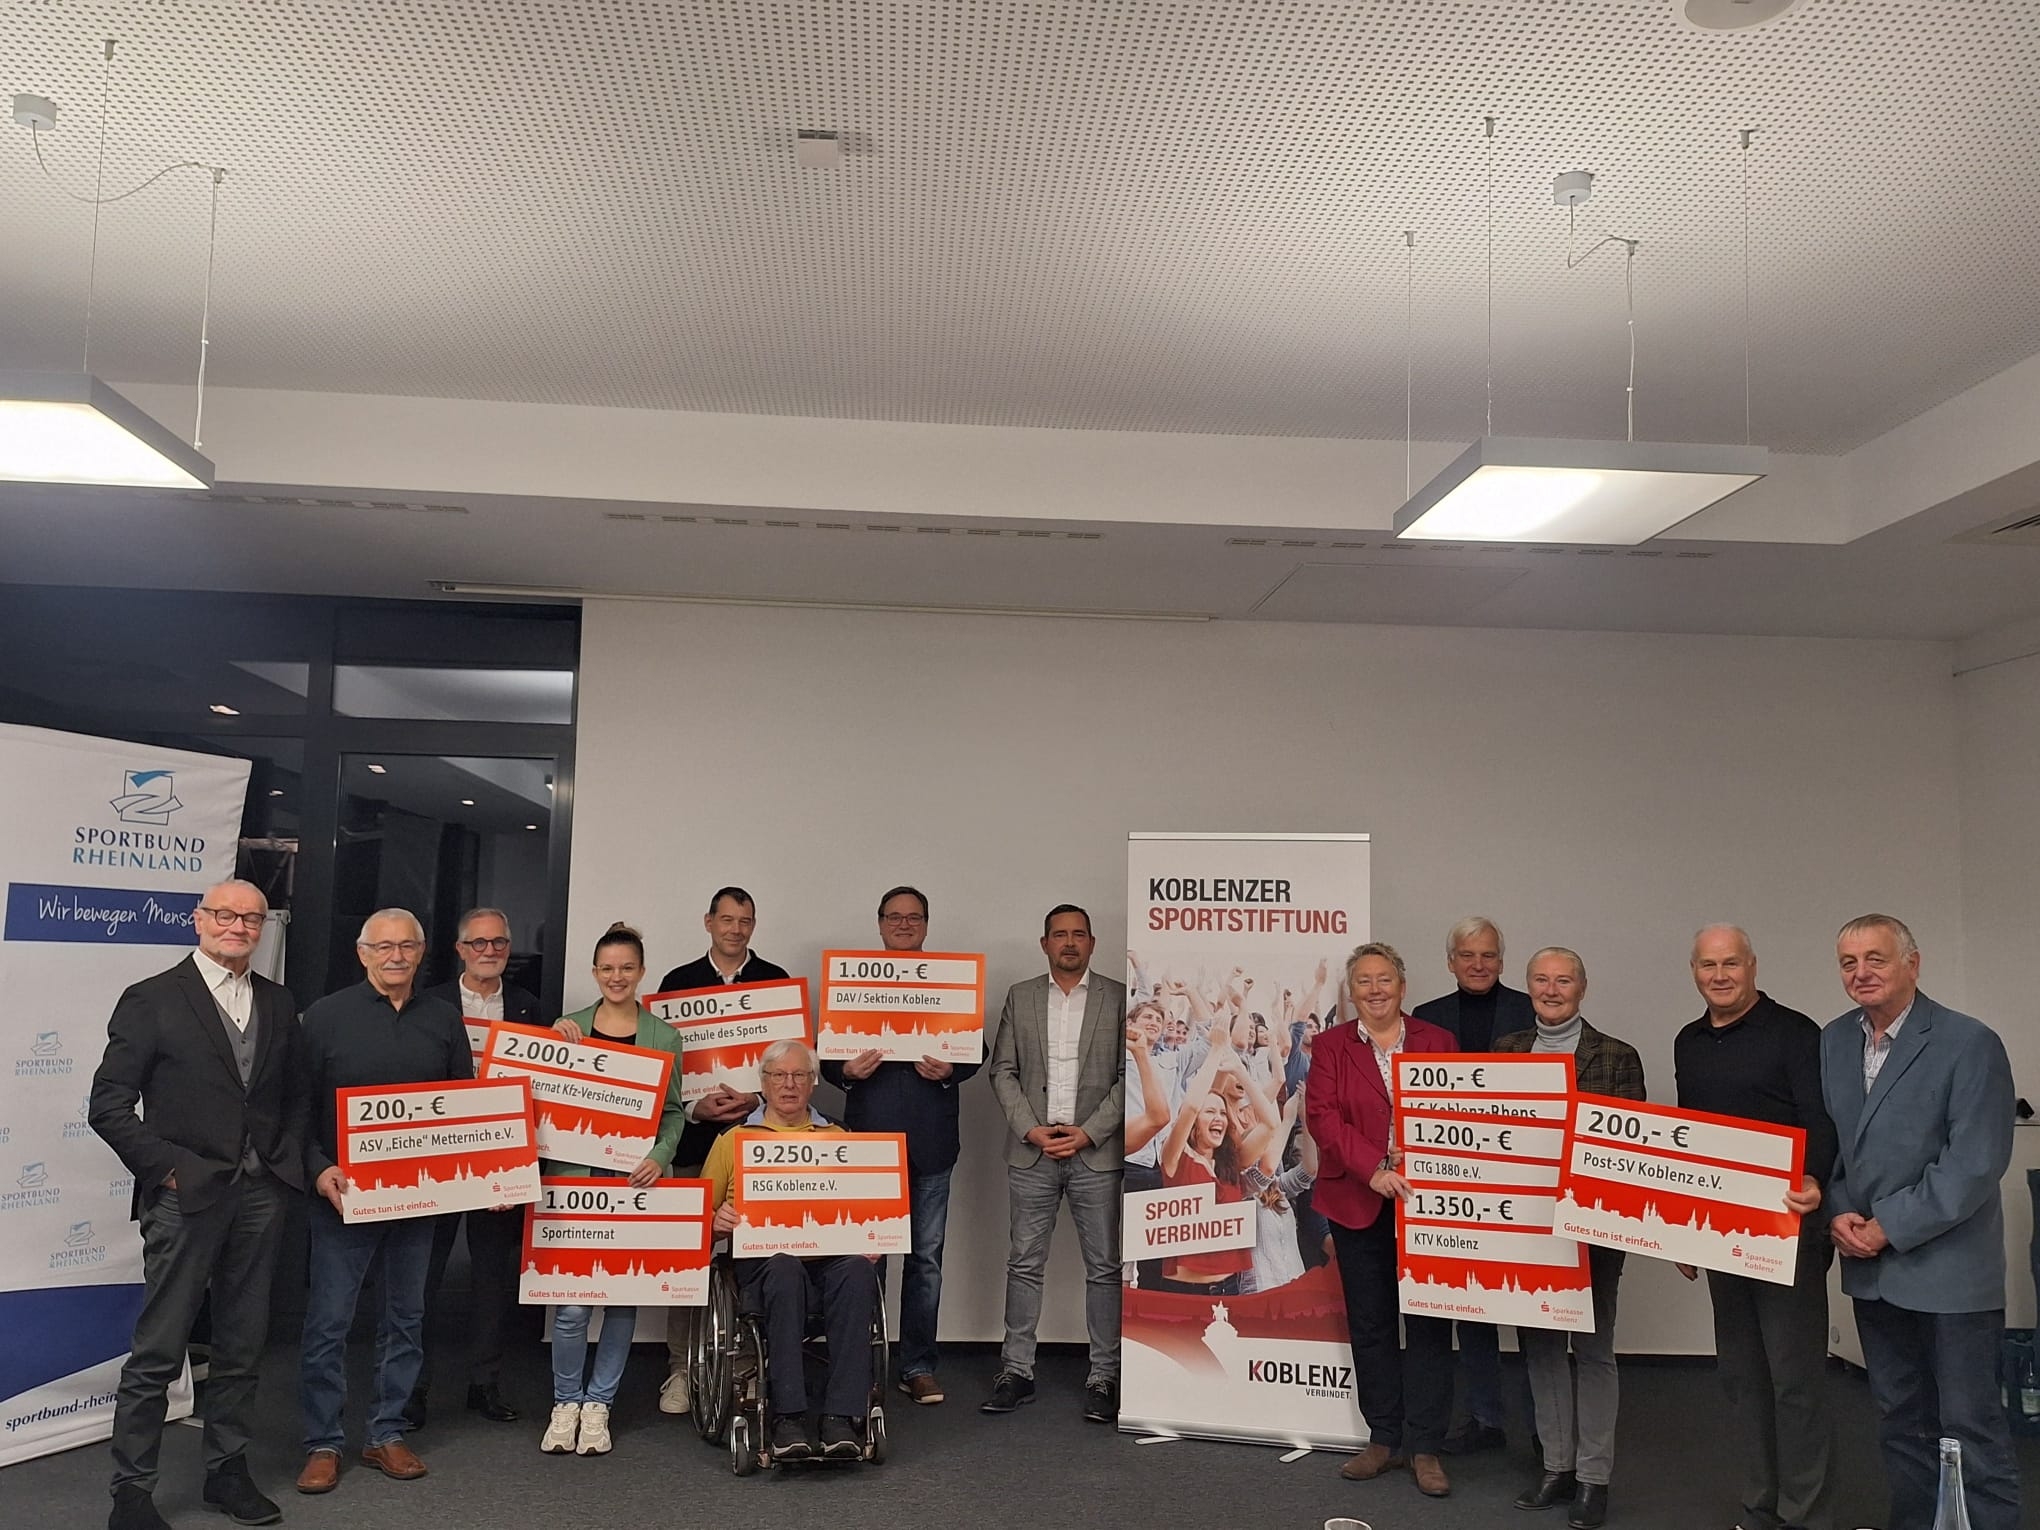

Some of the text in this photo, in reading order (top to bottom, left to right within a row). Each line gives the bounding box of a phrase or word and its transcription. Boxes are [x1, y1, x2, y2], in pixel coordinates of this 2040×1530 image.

[75, 826, 205, 854] SPORTBUND
[72, 847, 202, 873] RHEINLAND
[1149, 878, 1291, 903] KOBLENZER
[39, 894, 200, 936] Wir bewegen Mensc
[1148, 907, 1347, 934] SPORTSTIFTUNG
[839, 962, 928, 981] 1.000,- €
[661, 994, 752, 1021] 1.000,- €
[836, 992, 856, 1003] DAV
[863, 993, 900, 1004] Sektion
[902, 994, 941, 1006] Koblenz
[682, 1024, 768, 1043] schule des Sports
[16, 1058, 73, 1068] SPORTBUND
[503, 1037, 608, 1072] 2.000,- €
[15, 1066, 72, 1077] RHEINLAND
[1409, 1067, 1486, 1090] 200,- €
[562, 1084, 643, 1111] Kfz-Versicherung
[359, 1095, 446, 1121] 200,- €
[1414, 1122, 1512, 1151] 1.200,- €
[1588, 1110, 1690, 1148] 200,- €
[359, 1127, 514, 1153] ASV „Eiche“ Metternich e.V.
[752, 1145, 848, 1165] 9.250,- €
[1413, 1160, 1481, 1179] CTG 1880 e.V.
[1583, 1151, 1723, 1190] Post-SV Koblenz e.V.
[1, 1187, 60, 1201] SPORTBUND
[752, 1180, 838, 1191] RSG Koblenz e.V.
[1, 1196, 60, 1210] RHEINLAND
[352, 1200, 438, 1216] Gutes tun ist einfach.
[546, 1190, 648, 1213] 1.000,- €
[1145, 1197, 1203, 1221] SPORT
[1415, 1194, 1513, 1221] 1.350,- €
[541, 1227, 615, 1241] Sportinternat
[1145, 1217, 1244, 1247] VERBINDET
[1413, 1232, 1479, 1250] KTV Koblenz
[1563, 1222, 1663, 1251] Gutes tun ist einfach.
[50, 1246, 106, 1260] SPORTBUND
[742, 1242, 764, 1250] Gutes
[791, 1241, 820, 1249] einfach.
[49, 1254, 105, 1269] RHEINLAND
[1744, 1261, 1775, 1274] Koblenz
[1745, 1252, 1783, 1266] Sparkasse
[528, 1289, 609, 1299] Gutes tun ist einfach.
[1407, 1299, 1486, 1315] Gutes tun ist einfach.
[1552, 1306, 1584, 1317] Sparkasse
[1552, 1315, 1578, 1324] Koblenz
[1248, 1359, 1352, 1389] KOBLENZ
